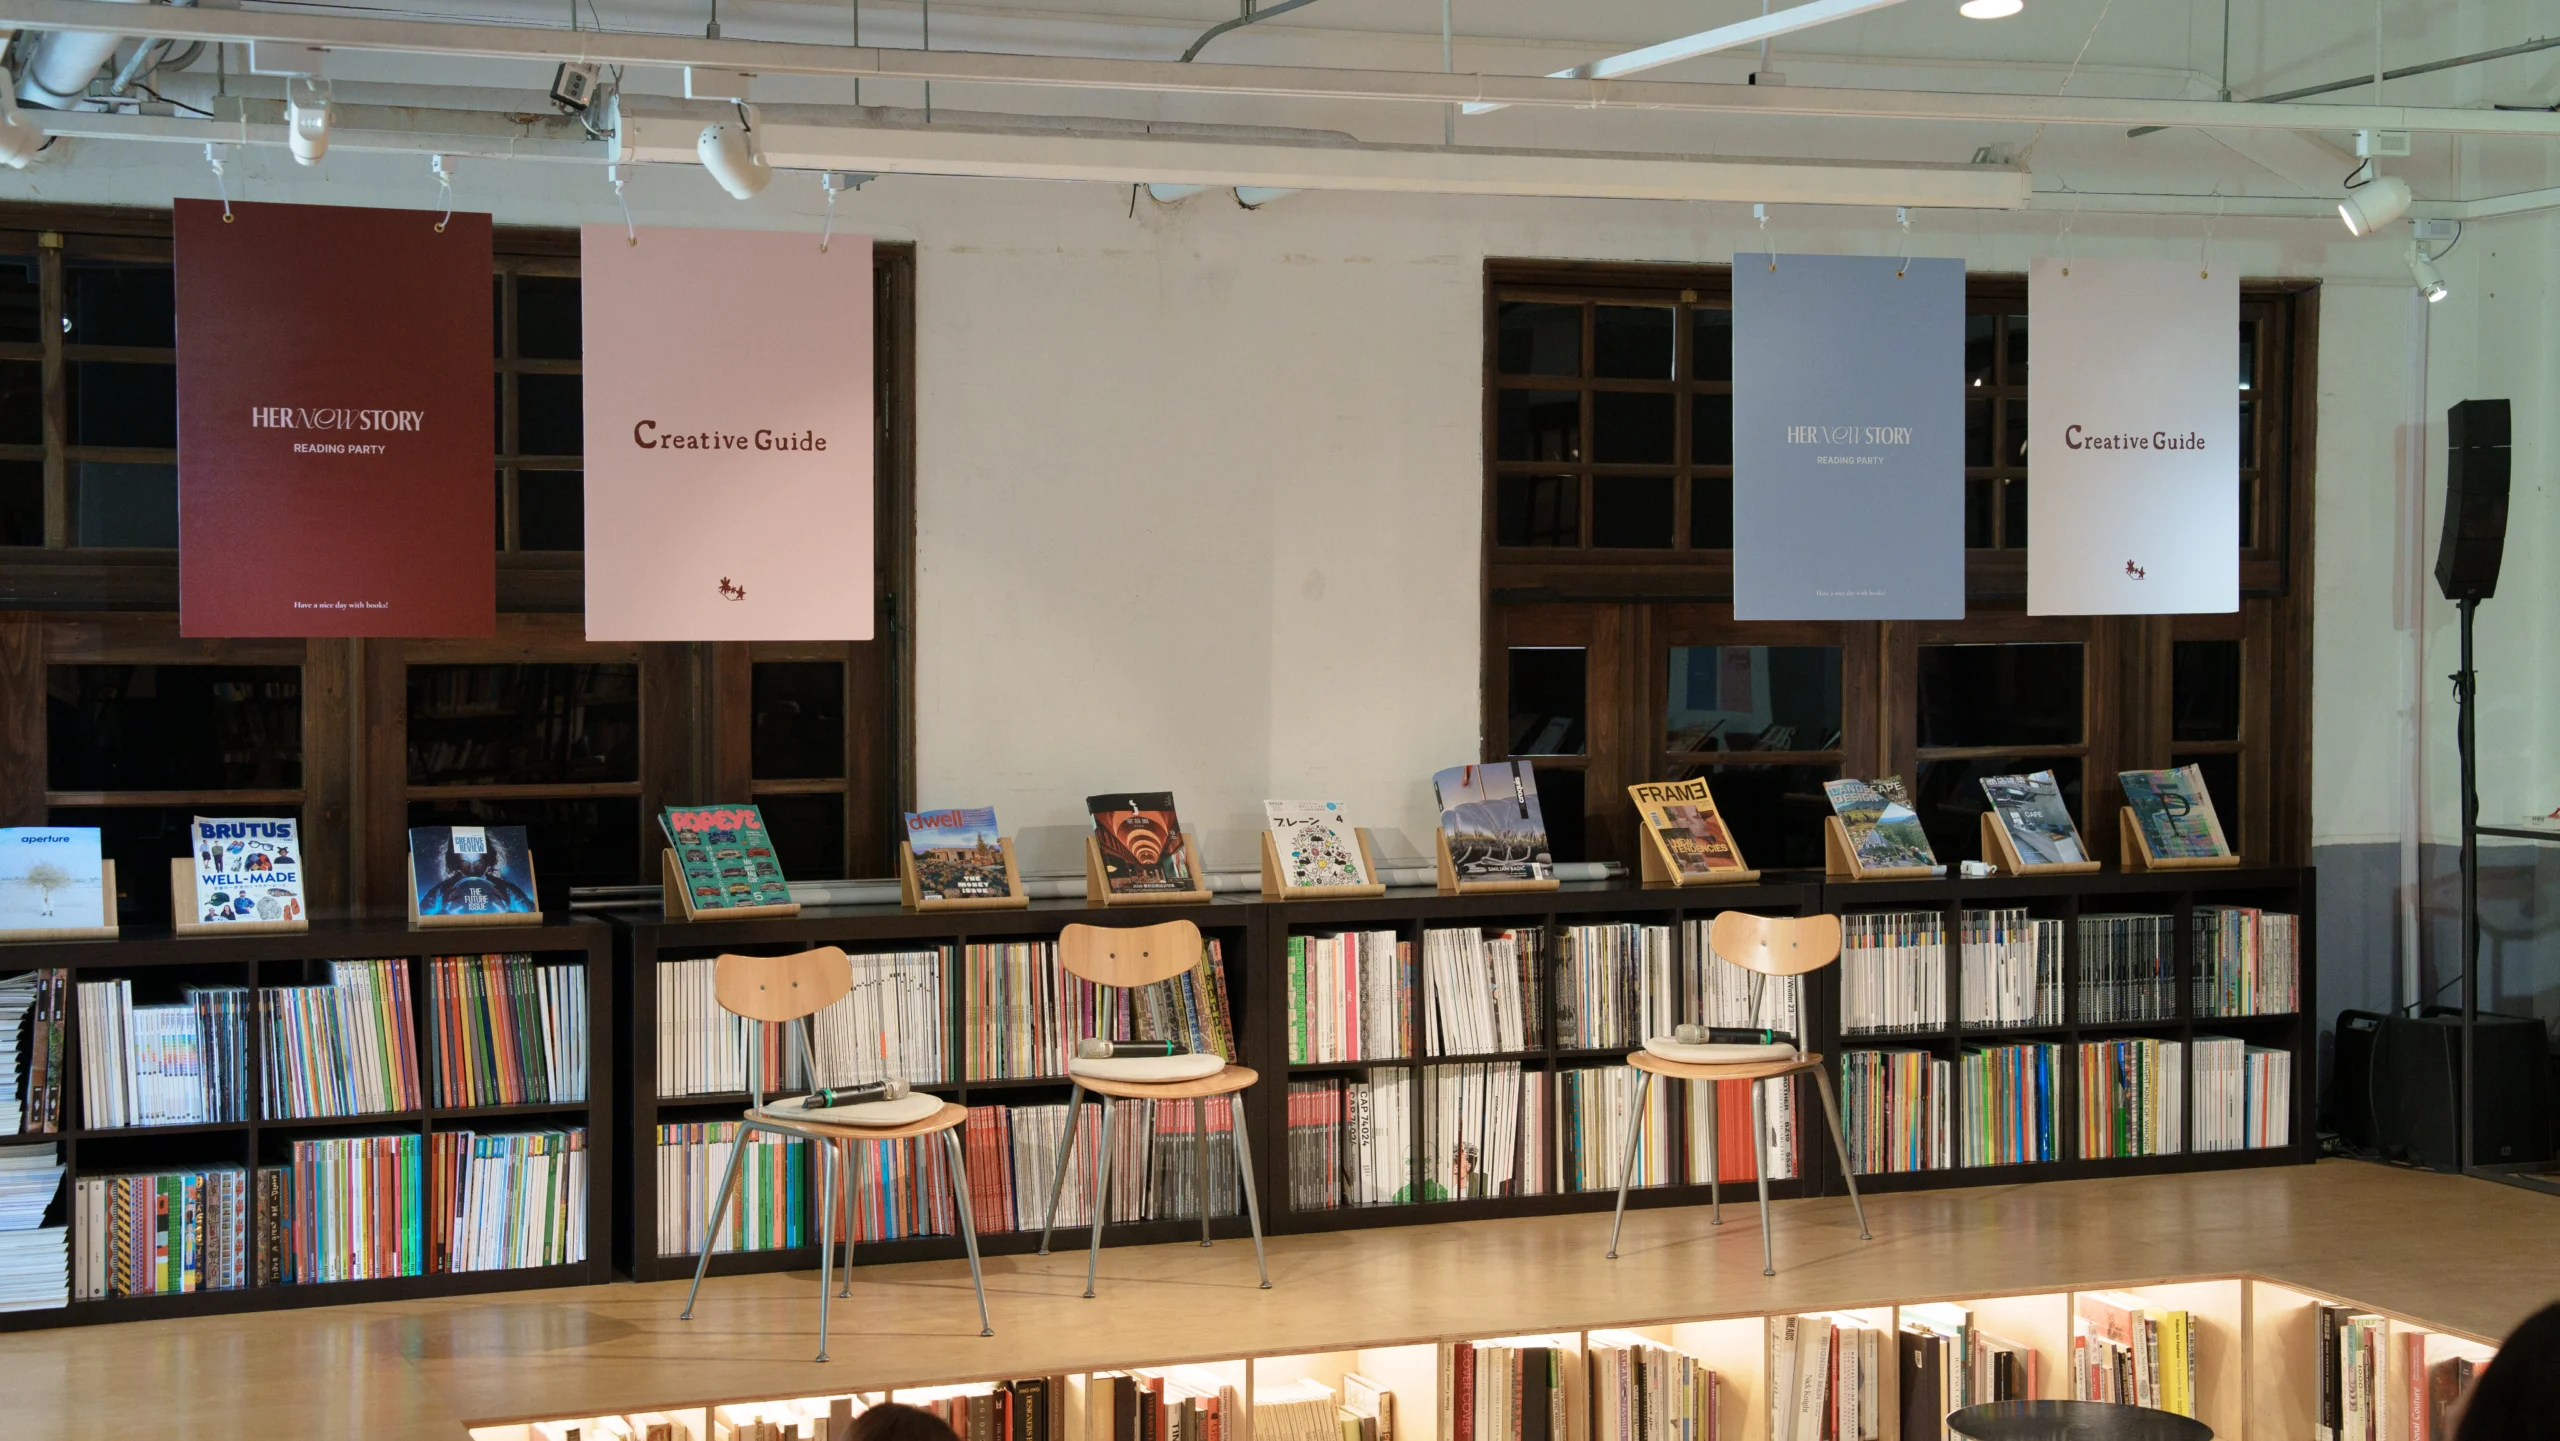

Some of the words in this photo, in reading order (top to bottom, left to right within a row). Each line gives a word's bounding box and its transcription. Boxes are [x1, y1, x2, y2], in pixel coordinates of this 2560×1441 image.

[634, 420, 748, 449] Creative
[755, 429, 827, 451] Guide
[2065, 424, 2149, 450] Creative
[2153, 431, 2205, 450] Guide
[293, 443, 345, 454] READING
[348, 445, 386, 455] PARTY
[1817, 456, 1855, 465] READING
[1856, 457, 1884, 465] PARTY
[294, 601, 312, 609] Have
[319, 601, 333, 609] nice
[335, 601, 347, 611] day
[348, 601, 364, 609] with
[366, 601, 389, 609] books!
[1830, 781, 1903, 795] LANDSCAPE
[1833, 793, 1879, 803] DESIGN
[671, 808, 761, 832] POPEYE
[909, 810, 963, 831] dwell
[1336, 814, 1344, 823] 4
[199, 821, 292, 839] BRUTUS
[21, 835, 70, 844] aperture
[455, 836, 484, 846] CREATIVE
[1671, 838, 1693, 847] NEW
[459, 844, 485, 852] REVIEW
[1672, 844, 1729, 853] TENDENCIES
[202, 872, 297, 886] WELL-MADE
[469, 888, 482, 896] THE
[754, 892, 763, 900] 5
[464, 895, 489, 904] FUTURE
[468, 903, 487, 911] ISSUE
[1788, 1004, 1795, 1013] 23
[1360, 1091, 1368, 1113] CAP
[2144, 1107, 2150, 1118] OF
[1361, 1114, 1370, 1147] 74024
[1785, 1317, 1796, 1341] 9HEADS
[1818, 1336, 1828, 1379] REIGNING
[1462, 1349, 1471, 1390] COVER
[1804, 1374, 1813, 1390] Nick
[1815, 1380, 1823, 1400] MEN
[1801, 1390, 1811, 1413] Knight
[2412, 1387, 2421, 1421] Couture
[1462, 1392, 1471, 1434] COVER
